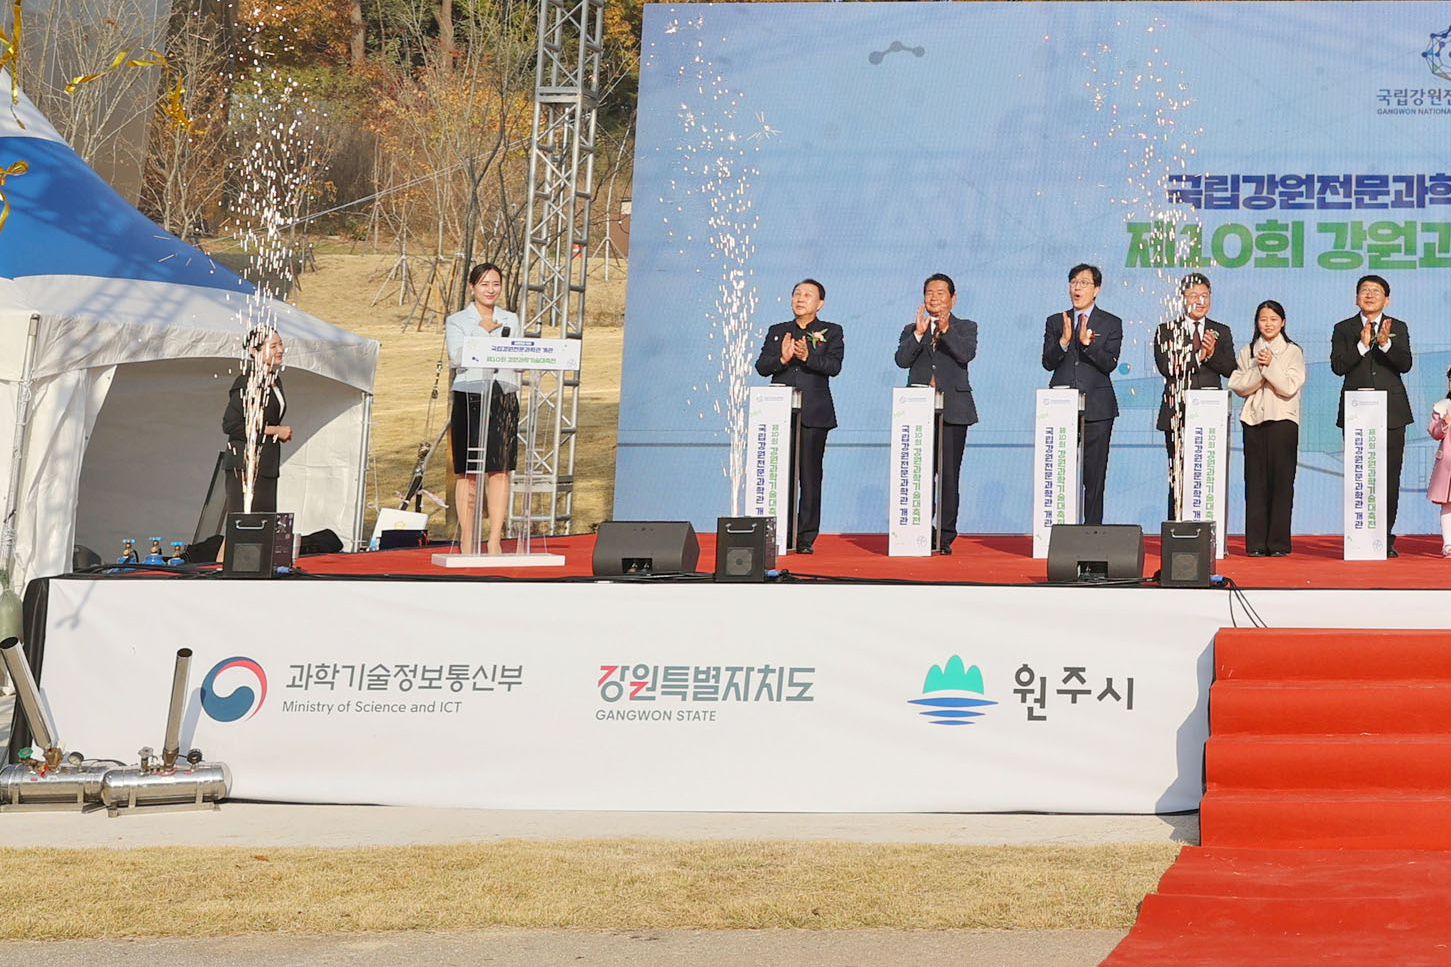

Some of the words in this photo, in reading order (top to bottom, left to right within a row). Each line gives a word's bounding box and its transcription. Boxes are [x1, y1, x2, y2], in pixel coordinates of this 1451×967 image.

[1125, 219, 1305, 269] 제10회
[286, 663, 524, 693] 과학기술정보통신부
[598, 663, 816, 703] 강원특별자치도
[1013, 664, 1134, 721] 원주시
[282, 701, 334, 716] Ministry
[337, 700, 351, 713] of
[354, 701, 407, 713] Science
[411, 701, 435, 713] and
[440, 701, 462, 713] ICT
[595, 710, 672, 721] GANGWON
[676, 710, 717, 722] STATE
